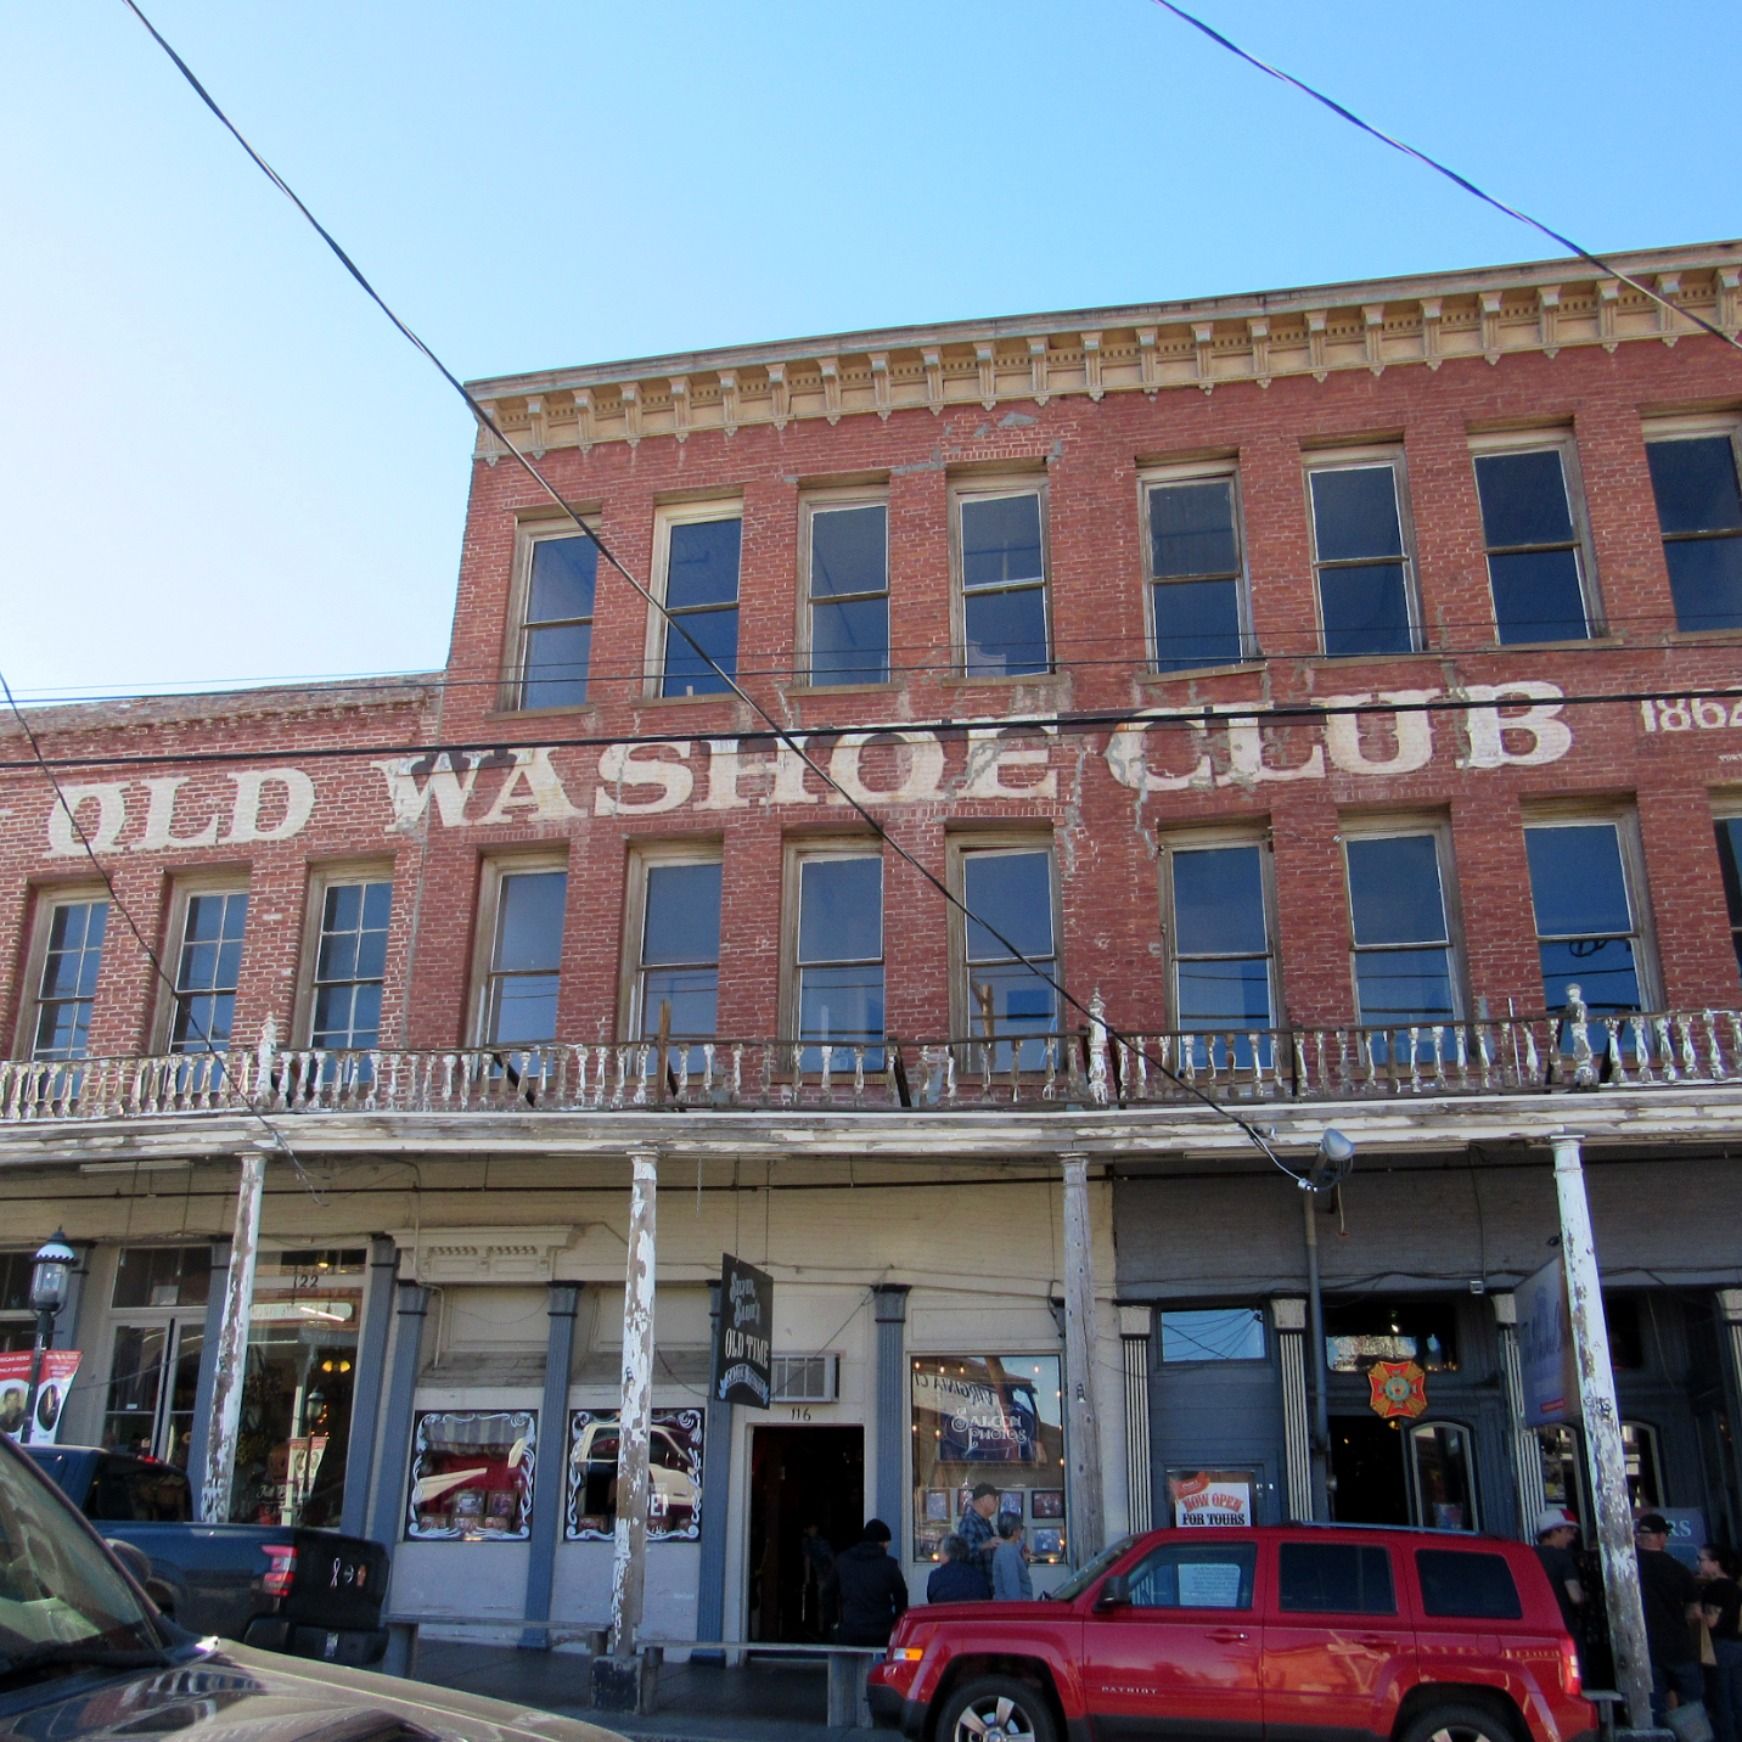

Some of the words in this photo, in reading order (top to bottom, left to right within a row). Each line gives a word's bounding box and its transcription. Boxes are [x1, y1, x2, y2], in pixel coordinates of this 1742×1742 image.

[43, 767, 316, 859] OLD
[371, 713, 1058, 832] WASHOE
[1106, 681, 1572, 791] CLUB
[293, 1274, 319, 1289] 122
[725, 1327, 744, 1359] OLD
[746, 1335, 769, 1370] TIME
[791, 1407, 812, 1421] 116
[952, 1407, 1022, 1432] SALOON
[966, 1428, 1027, 1450] PHOTOS
[1183, 1493, 1209, 1512] NOW
[1212, 1492, 1244, 1512] OPEN
[1183, 1513, 1205, 1525] FOR
[1207, 1513, 1245, 1525] TOURS
[1102, 1685, 1158, 1696] PATRIOT
